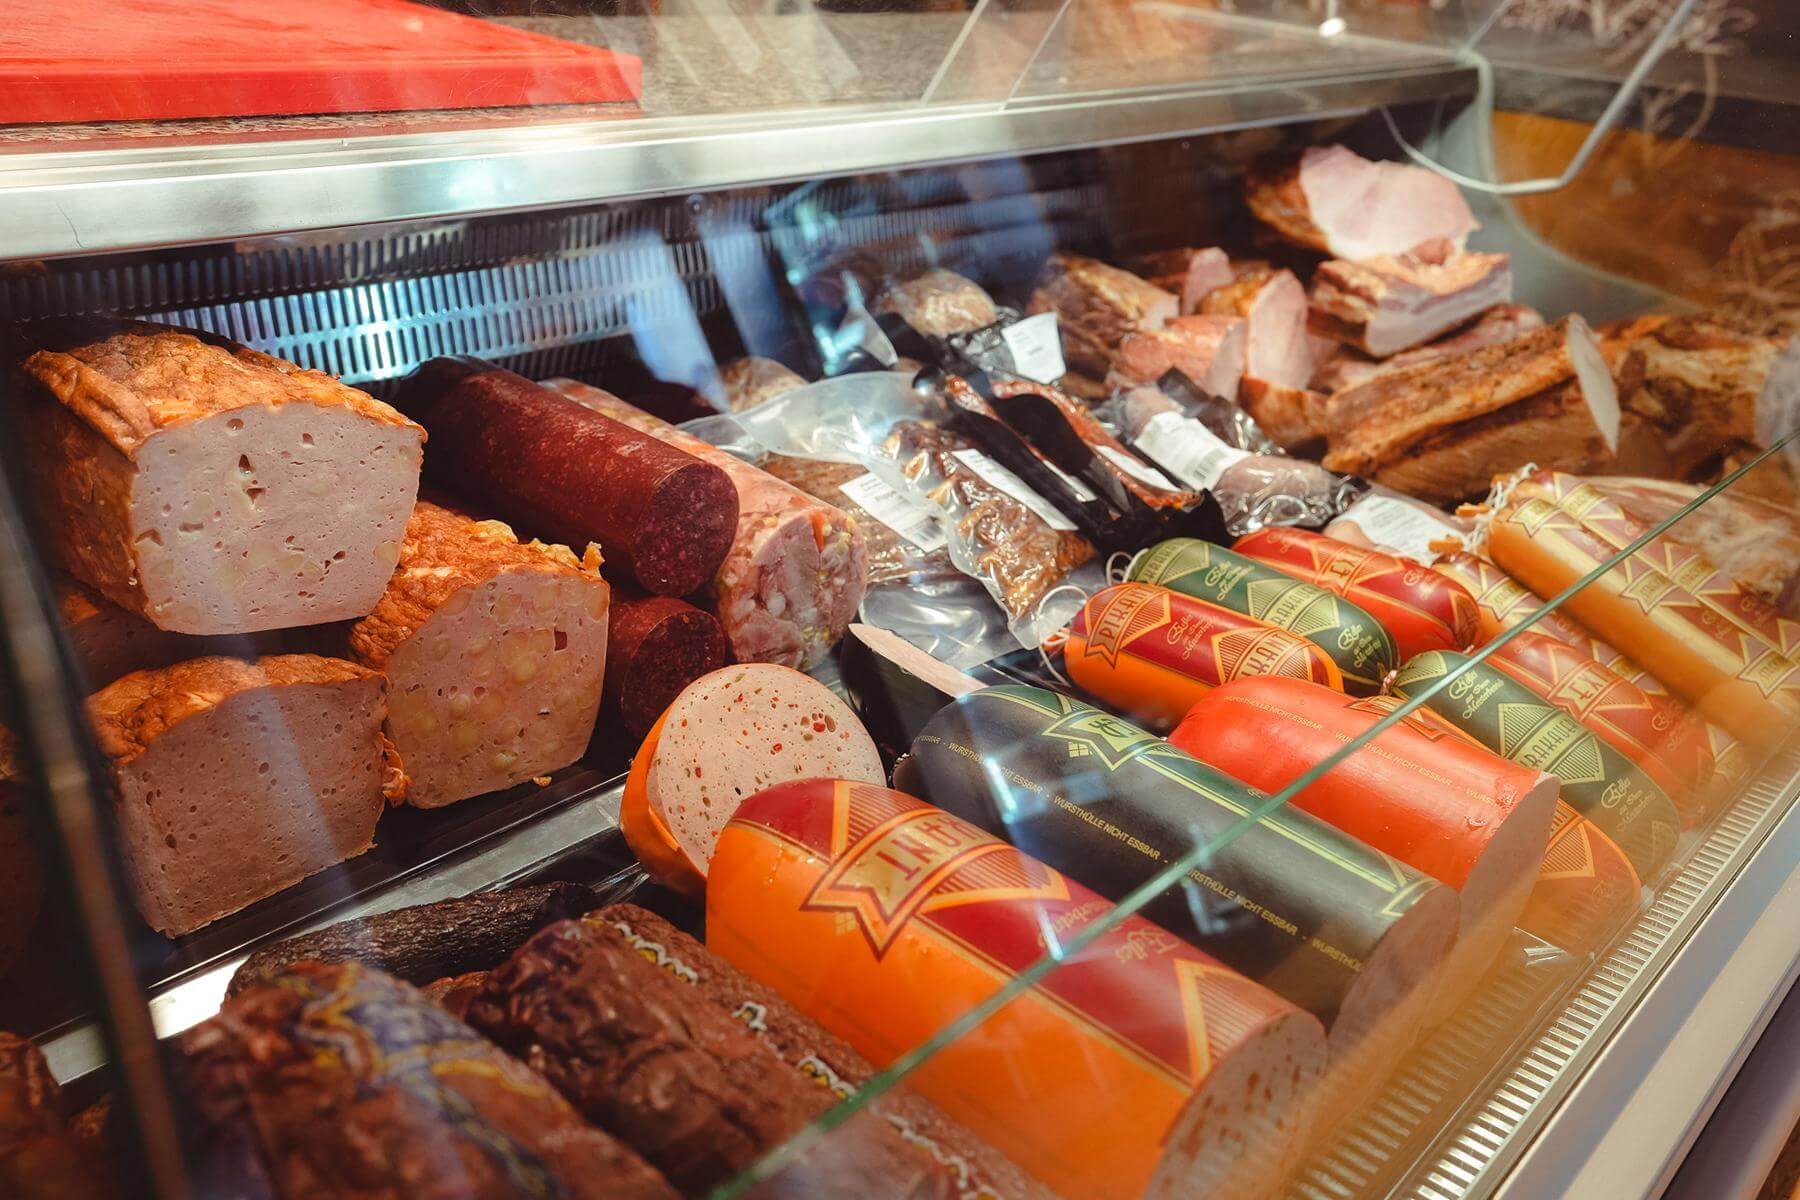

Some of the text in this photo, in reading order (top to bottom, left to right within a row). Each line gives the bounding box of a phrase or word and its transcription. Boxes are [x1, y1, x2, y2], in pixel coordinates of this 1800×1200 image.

[1054, 794, 1104, 830] WURSTHÜLLE
[1103, 823, 1129, 842] NICHT
[1127, 836, 1161, 861] ESSBAR
[1234, 892, 1263, 916] NICHT
[1260, 909, 1299, 937] ESSBAR
